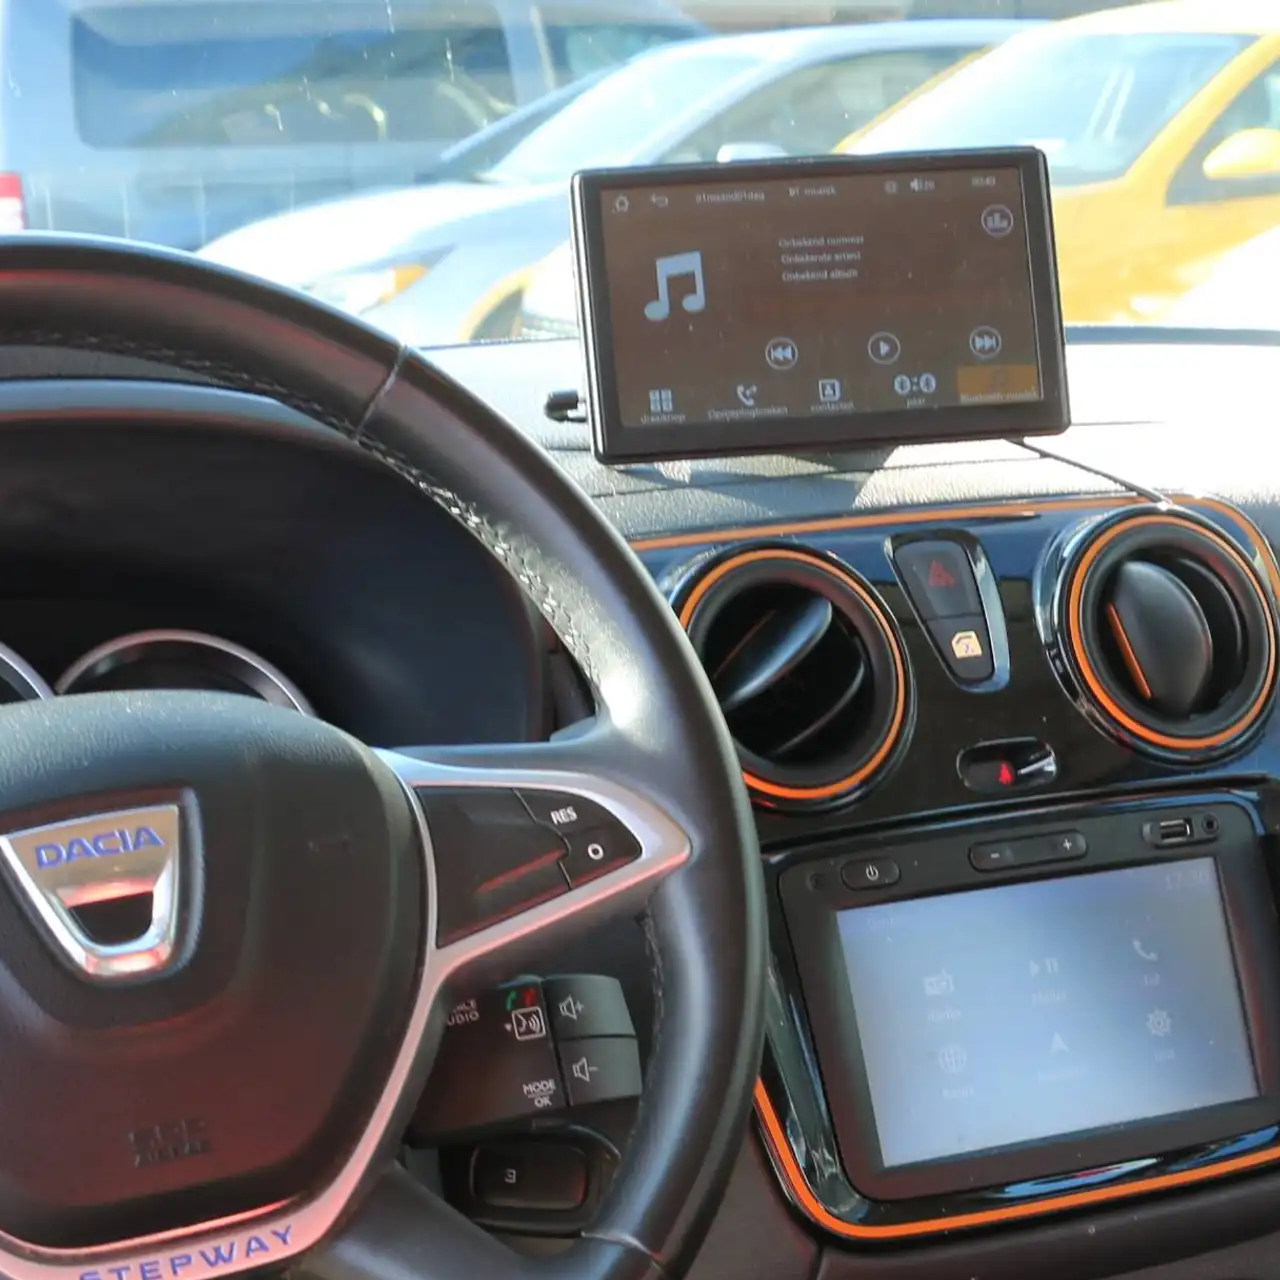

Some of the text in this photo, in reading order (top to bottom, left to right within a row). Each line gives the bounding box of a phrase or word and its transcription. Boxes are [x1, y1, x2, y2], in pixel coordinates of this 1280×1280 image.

[550, 806, 578, 826] RES
[35, 826, 166, 869] DACIA
[446, 1009, 480, 1027] UDIO
[522, 1078, 557, 1095] MODE
[534, 1095, 553, 1108] OK
